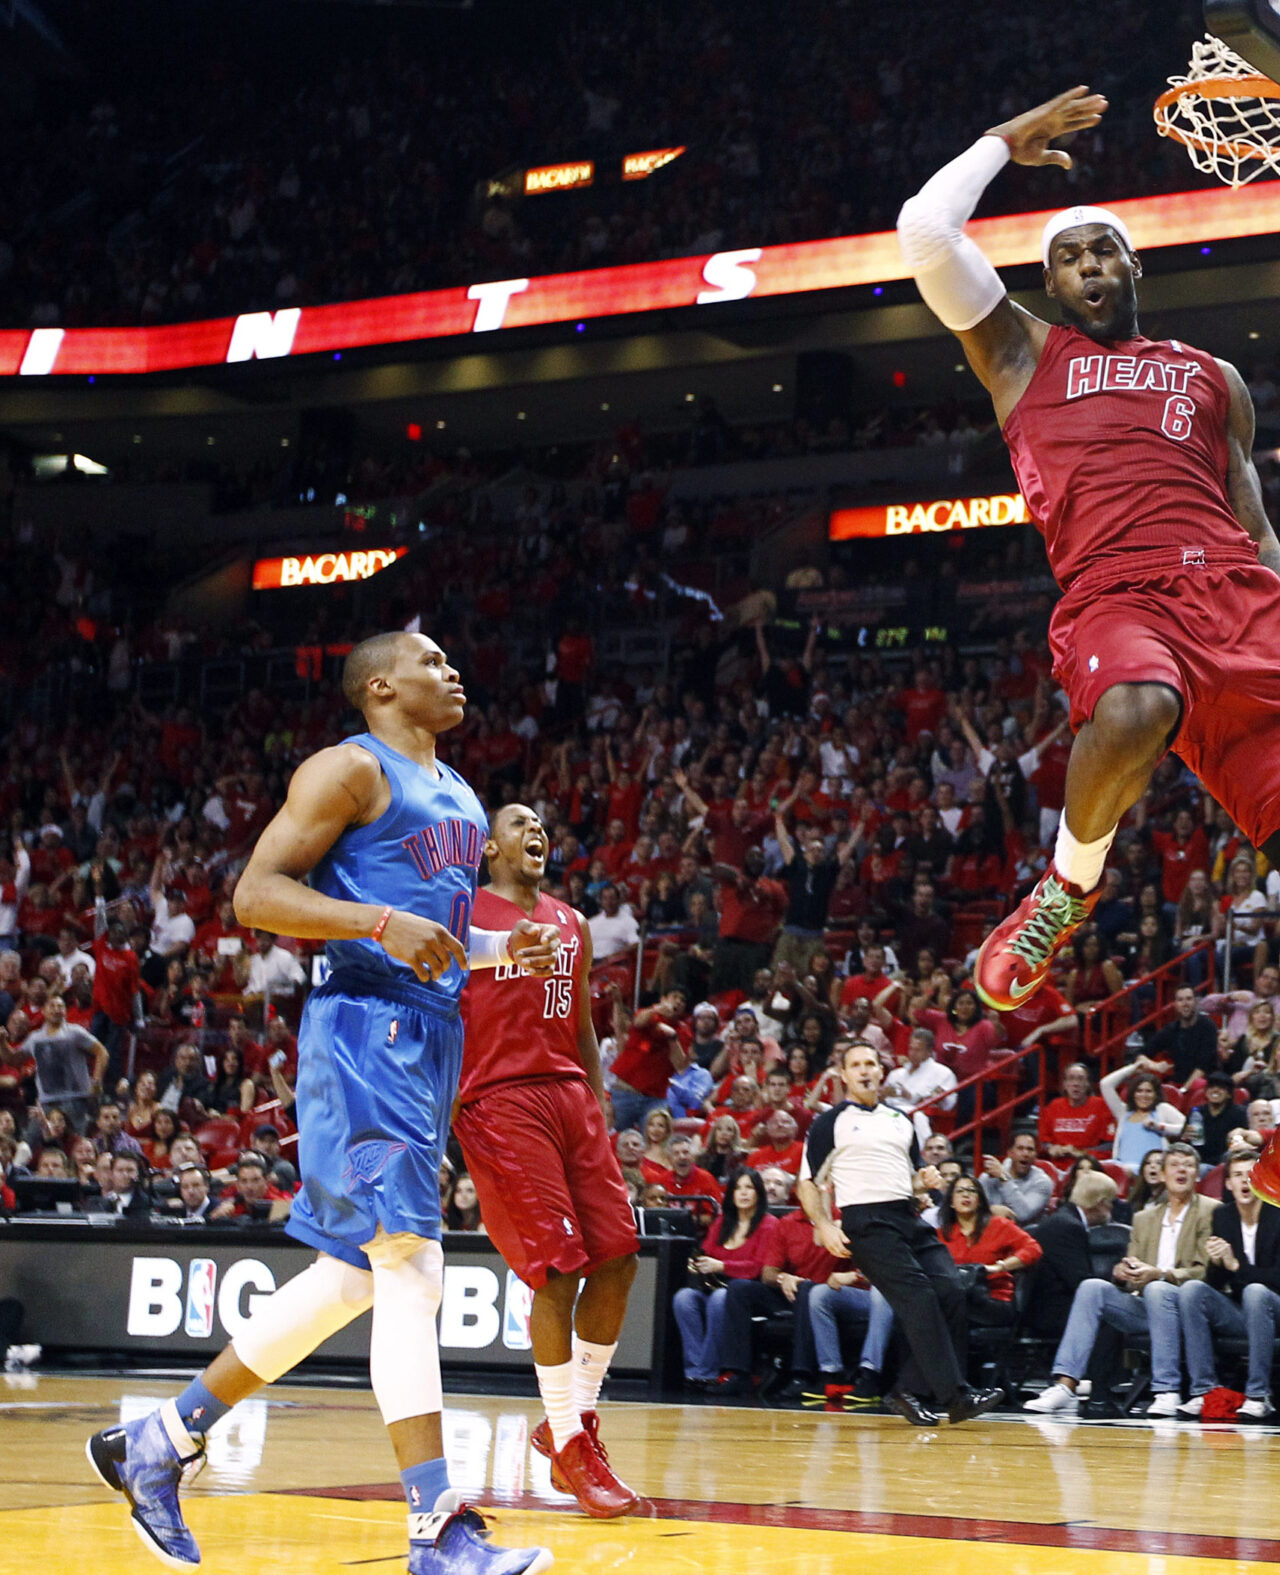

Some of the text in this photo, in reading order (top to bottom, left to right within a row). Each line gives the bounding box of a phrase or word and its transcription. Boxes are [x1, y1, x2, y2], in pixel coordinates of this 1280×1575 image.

[1066, 355, 1201, 400] HEAT
[1160, 394, 1196, 441] 6
[885, 496, 1028, 535] BACARDI
[543, 978, 573, 1019] 15
